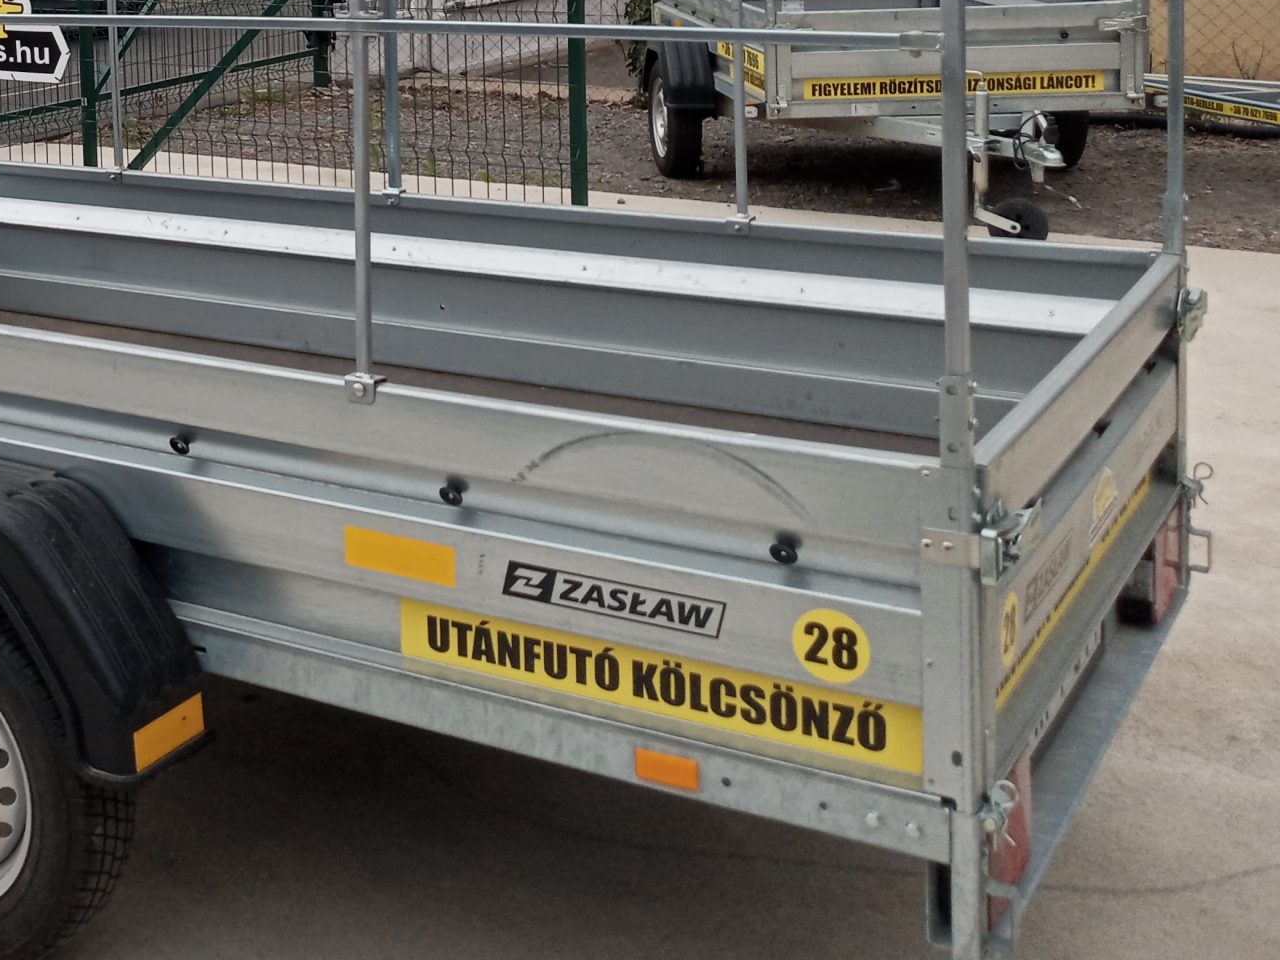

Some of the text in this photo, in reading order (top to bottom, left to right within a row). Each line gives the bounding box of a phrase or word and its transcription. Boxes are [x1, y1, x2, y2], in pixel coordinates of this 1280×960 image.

[811, 81, 876, 97] FIGYELEM!
[968, 73, 1037, 92] IZONSÁGI
[1040, 72, 1096, 90] LÁNCOT!
[558, 577, 715, 632] ZASŁAW
[802, 621, 859, 672] 28
[426, 615, 888, 753] UTÁNFUTÓ KÖLCSÖNZŐ
